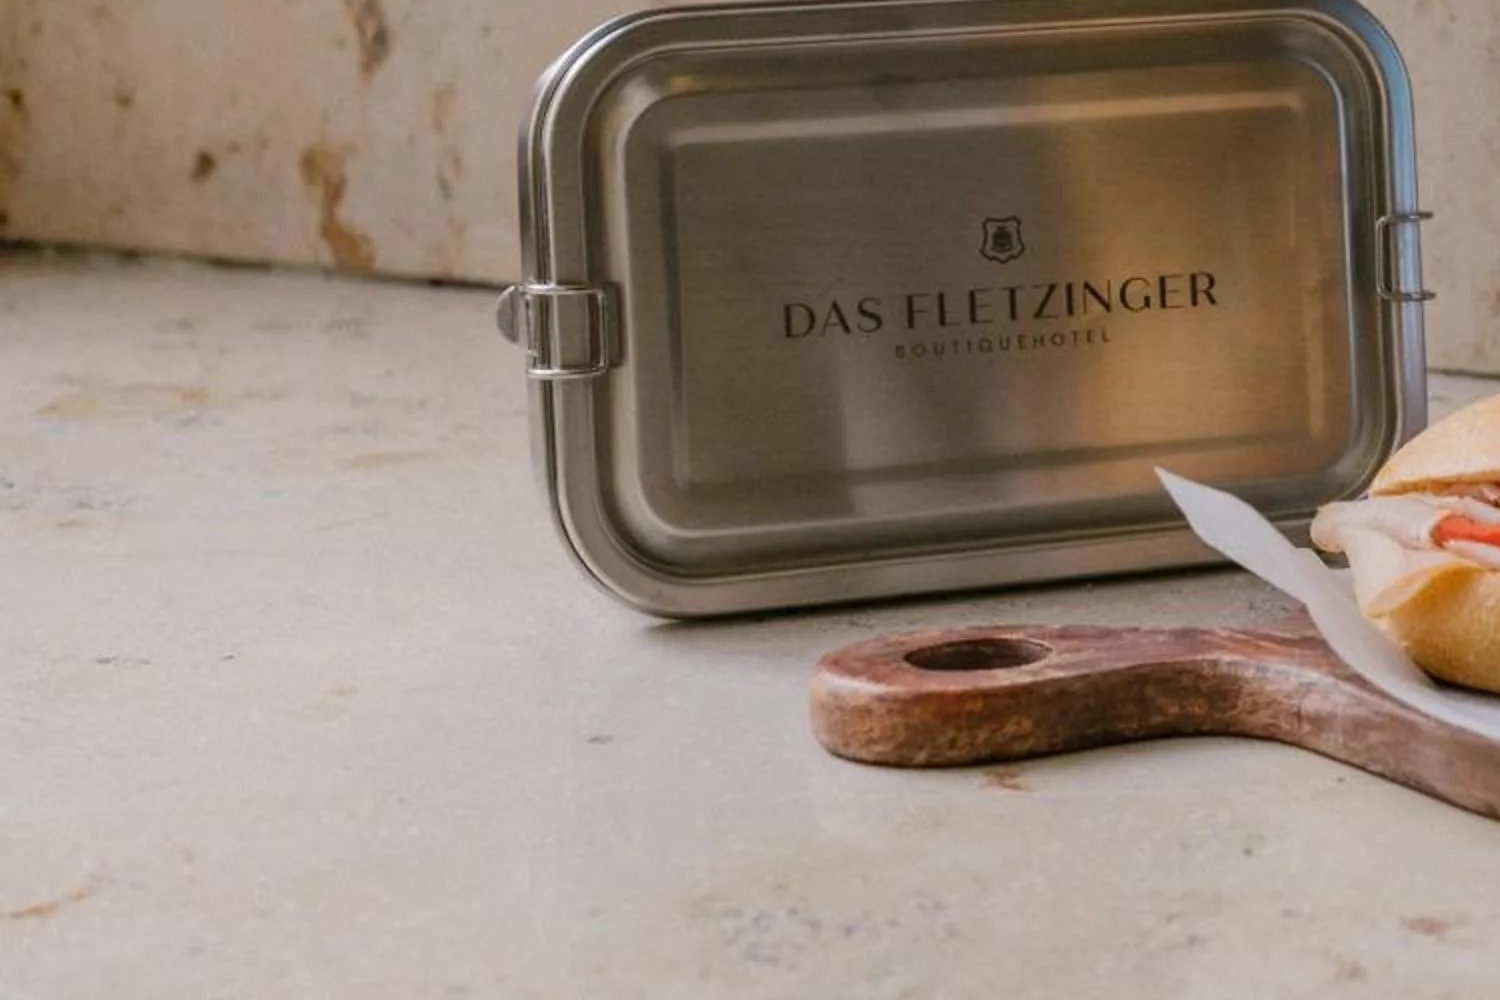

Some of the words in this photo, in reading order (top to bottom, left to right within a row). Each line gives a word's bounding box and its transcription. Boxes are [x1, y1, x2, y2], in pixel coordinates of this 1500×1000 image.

[782, 297, 884, 339] DAS
[906, 271, 1218, 329] FLETZINGER
[895, 330, 1112, 360] BOUTIQUEHOTEL
